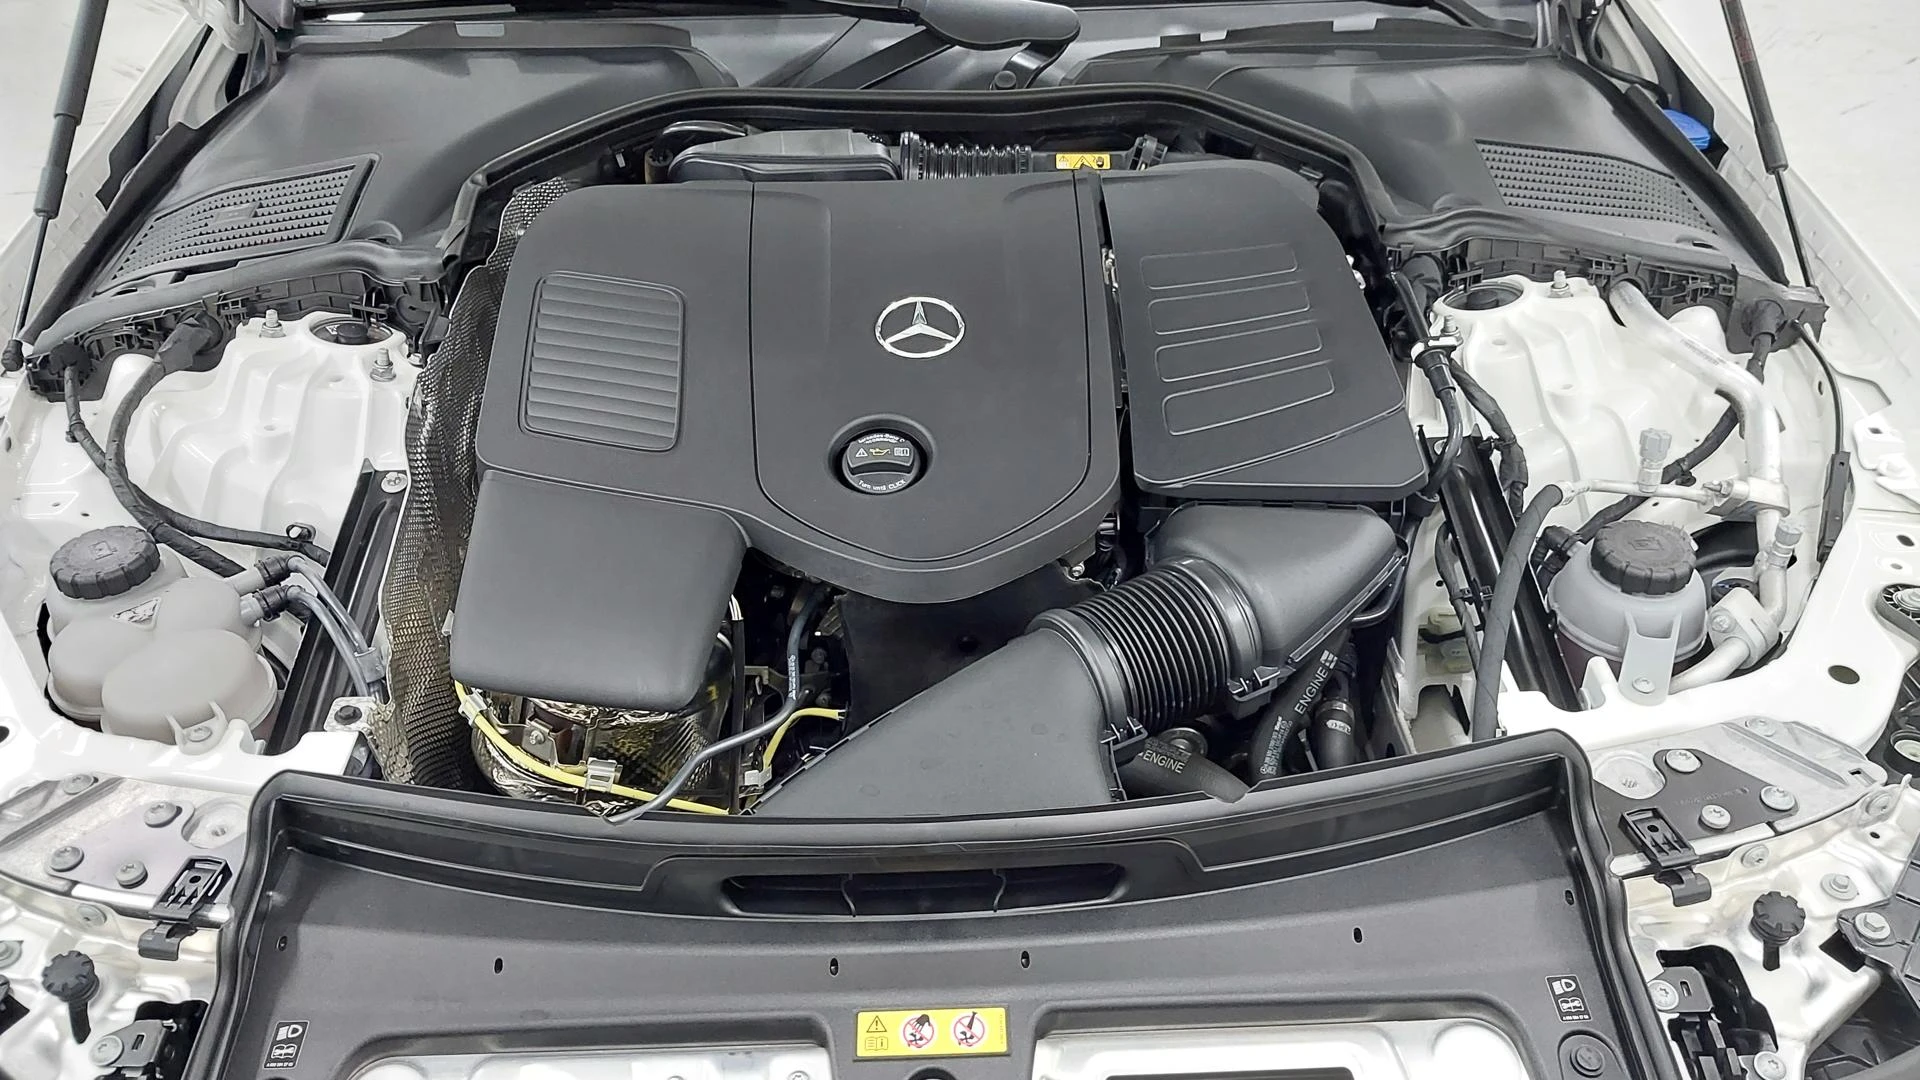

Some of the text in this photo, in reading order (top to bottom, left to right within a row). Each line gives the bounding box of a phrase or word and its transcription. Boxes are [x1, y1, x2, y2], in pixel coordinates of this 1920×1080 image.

[888, 479, 906, 489] CLICK
[1294, 666, 1329, 715] ENGINE
[1143, 750, 1185, 774] ENGINE
